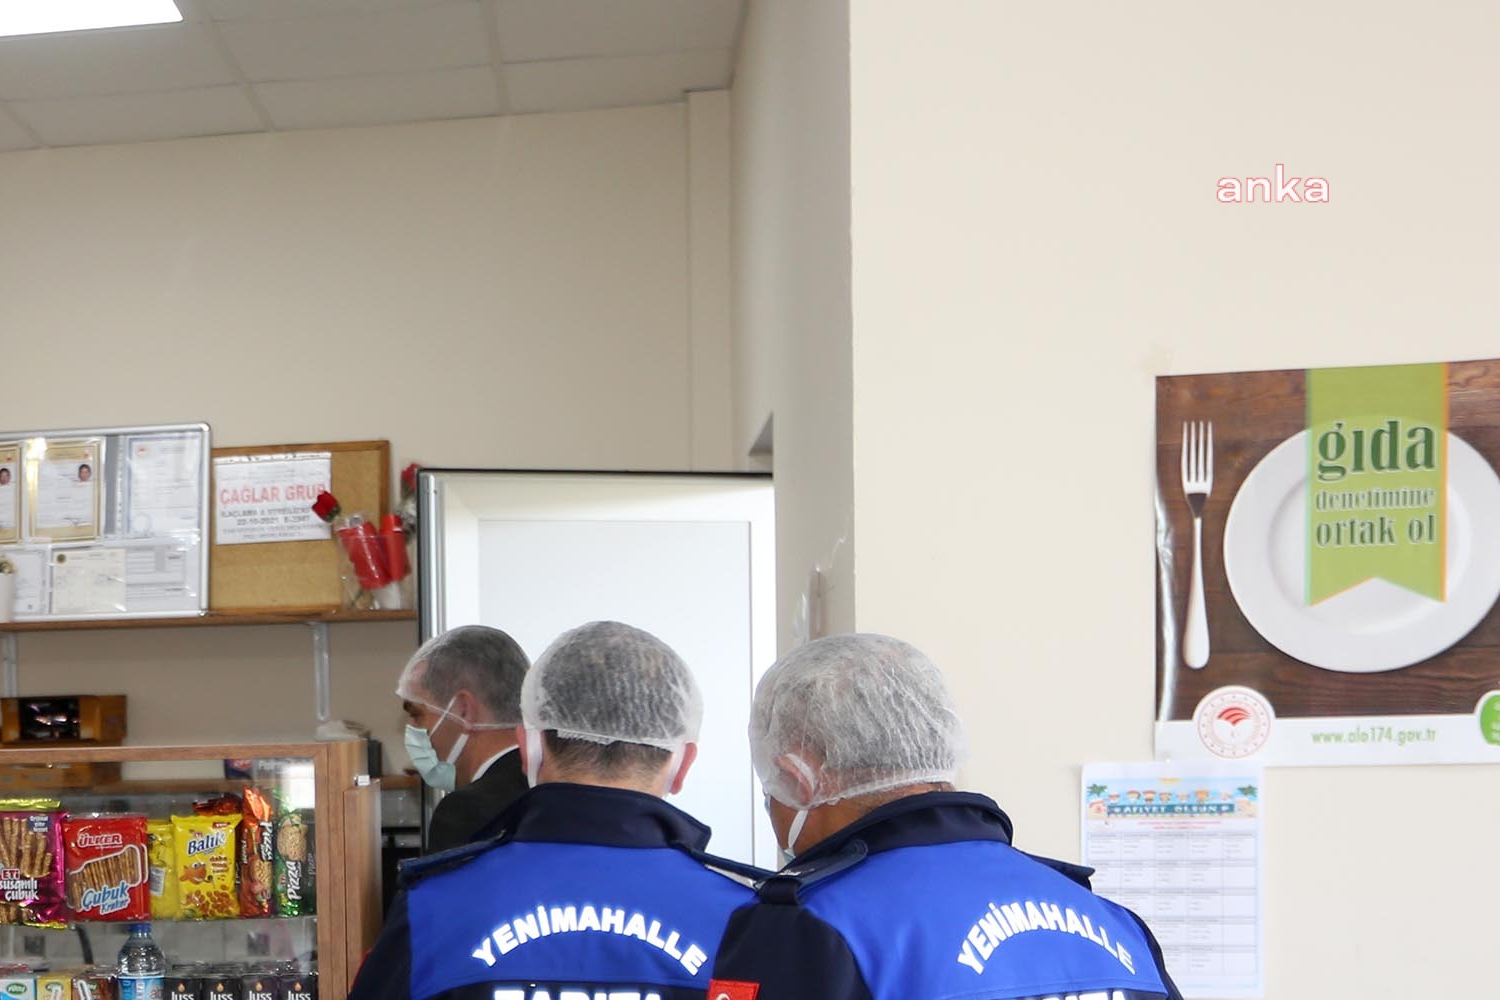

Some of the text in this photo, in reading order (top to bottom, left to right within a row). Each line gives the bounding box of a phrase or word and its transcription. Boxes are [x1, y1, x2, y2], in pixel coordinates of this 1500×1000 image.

[1316, 488, 1434, 511] denetimine
[1316, 514, 1435, 546] ortak ol
[77, 833, 123, 848] ÜLKER
[187, 831, 225, 856] Balık
[287, 861, 302, 901] Pizza
[5, 889, 40, 901] çubuk
[82, 880, 129, 910] Çubuk
[100, 899, 129, 915] Kraker
[471, 904, 708, 977] YENİMAHALLE
[956, 899, 1135, 976] YENİMAHALLE
